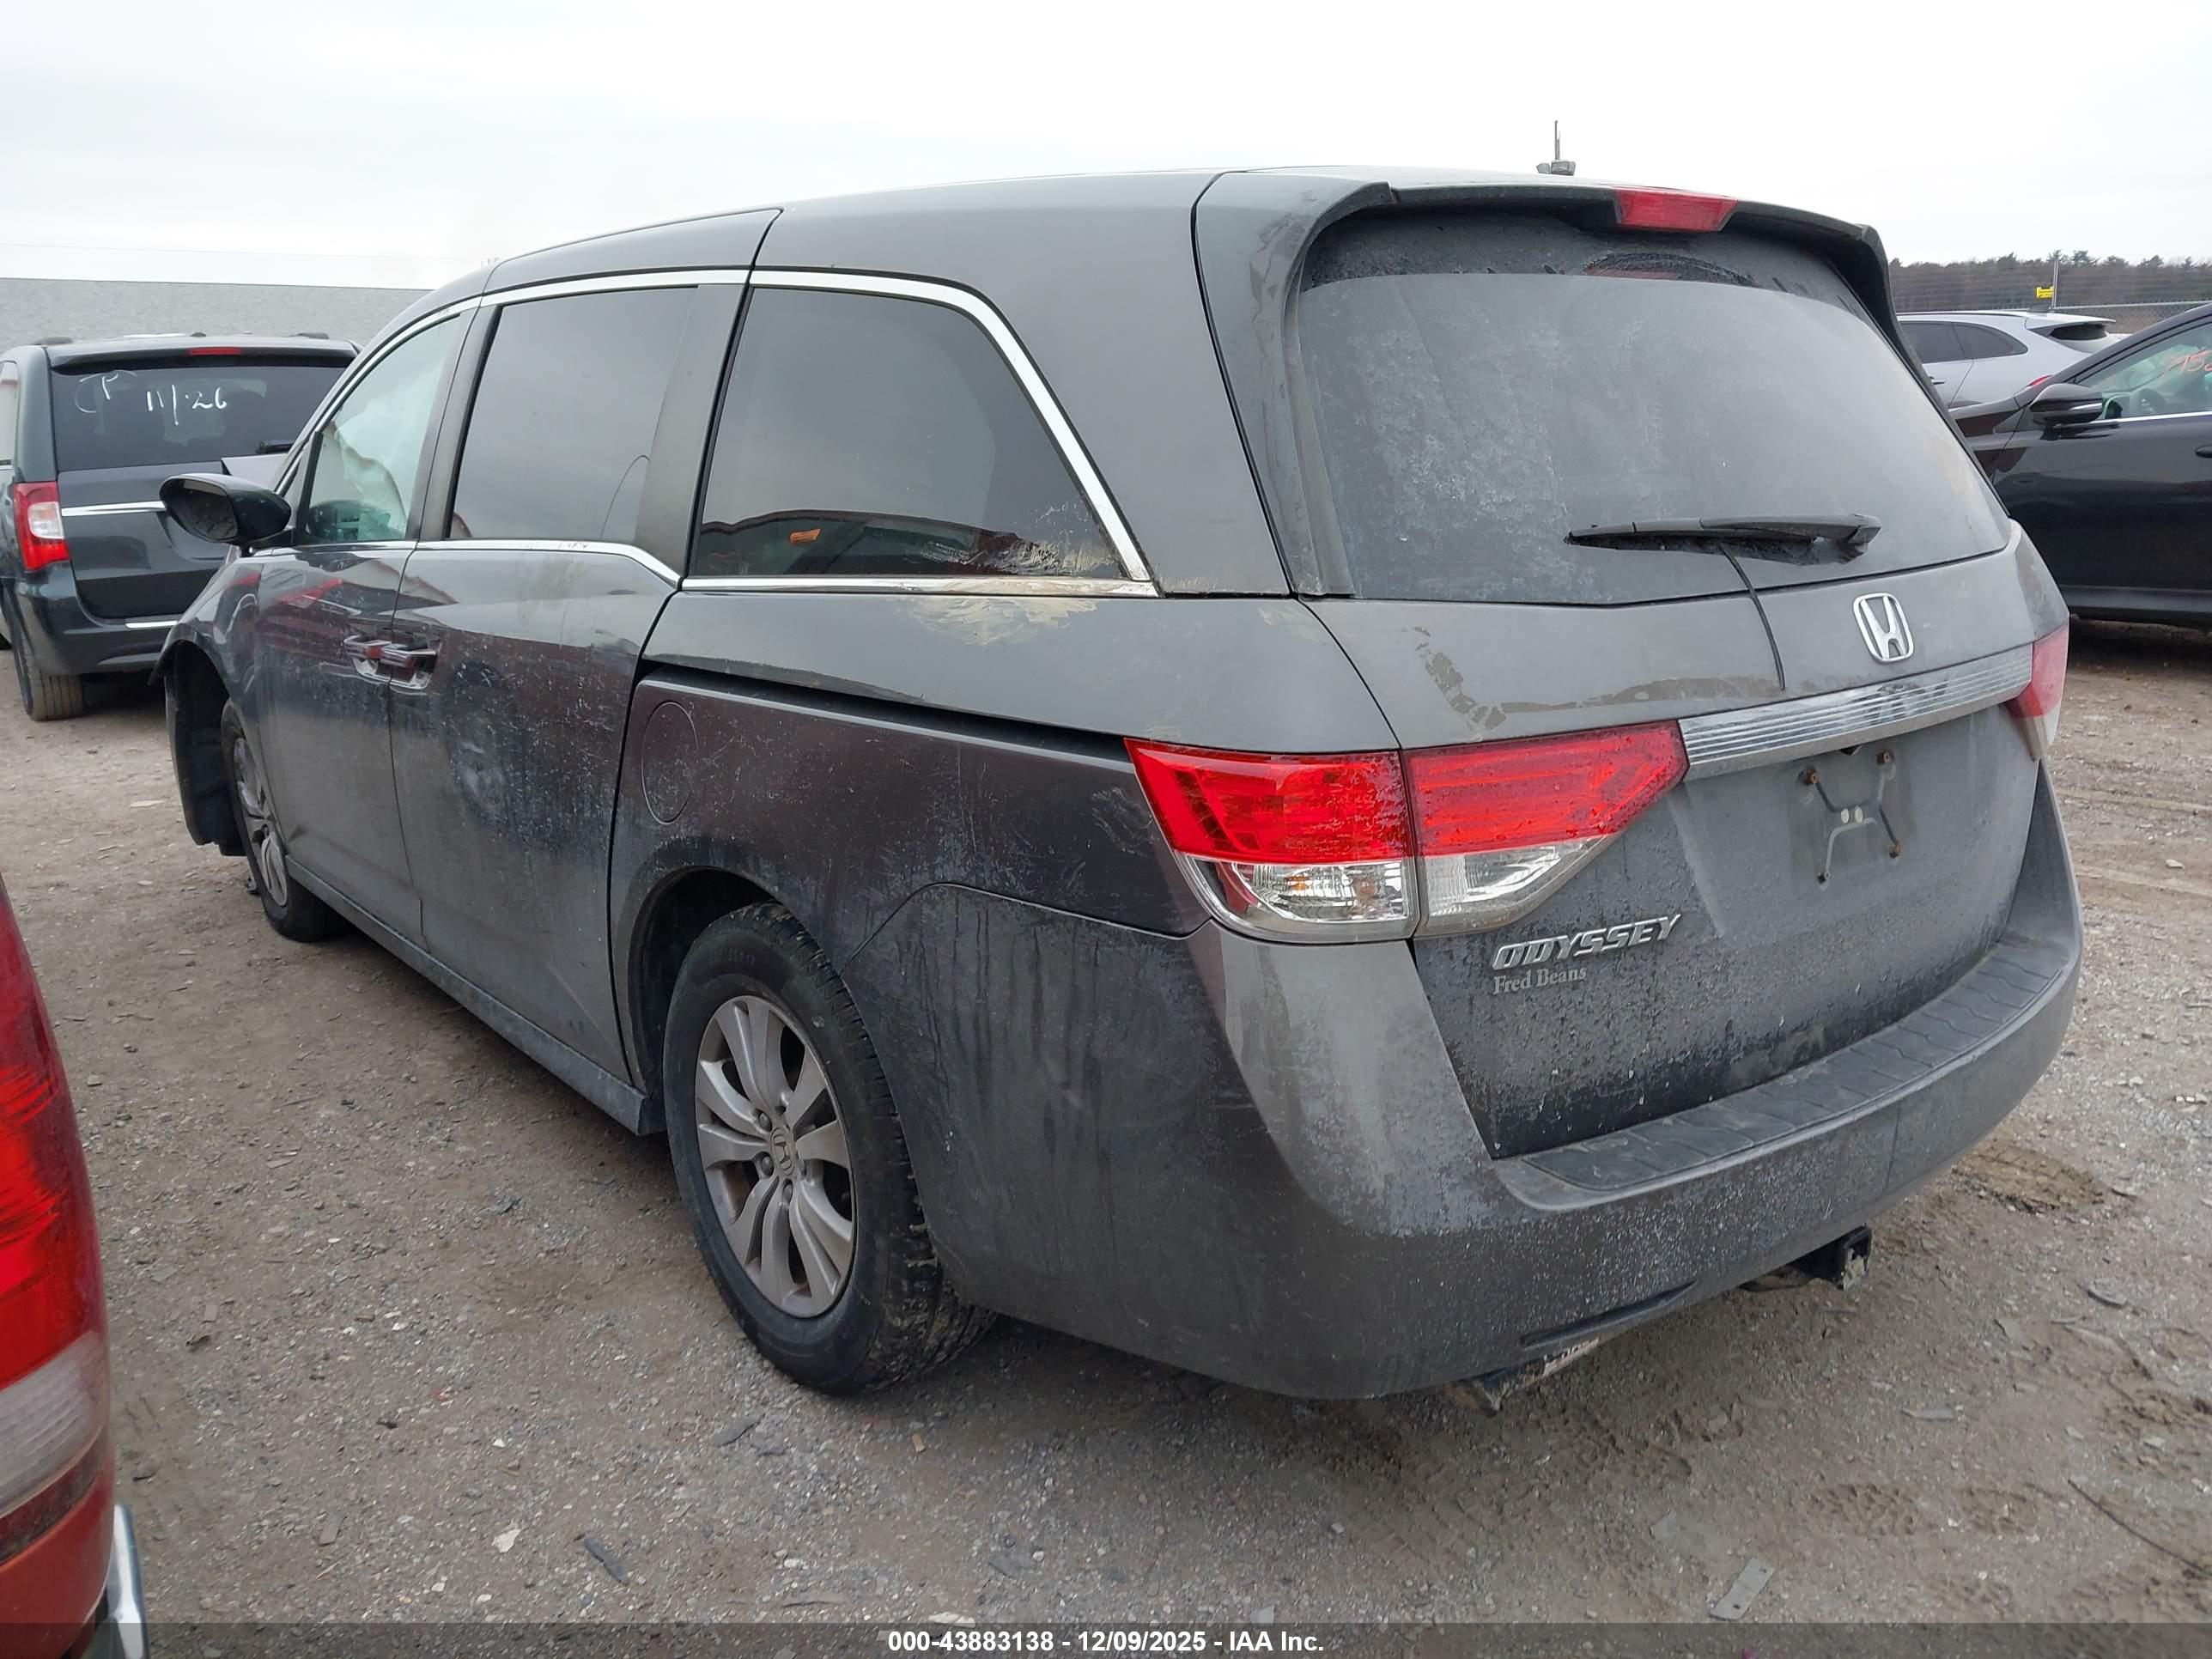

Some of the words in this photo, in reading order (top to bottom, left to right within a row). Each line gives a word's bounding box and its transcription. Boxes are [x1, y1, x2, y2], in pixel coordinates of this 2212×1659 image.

[1492, 913, 1681, 970] ODYSSEY
[1492, 969, 1532, 995] Fred
[1536, 967, 1588, 988] Beans
